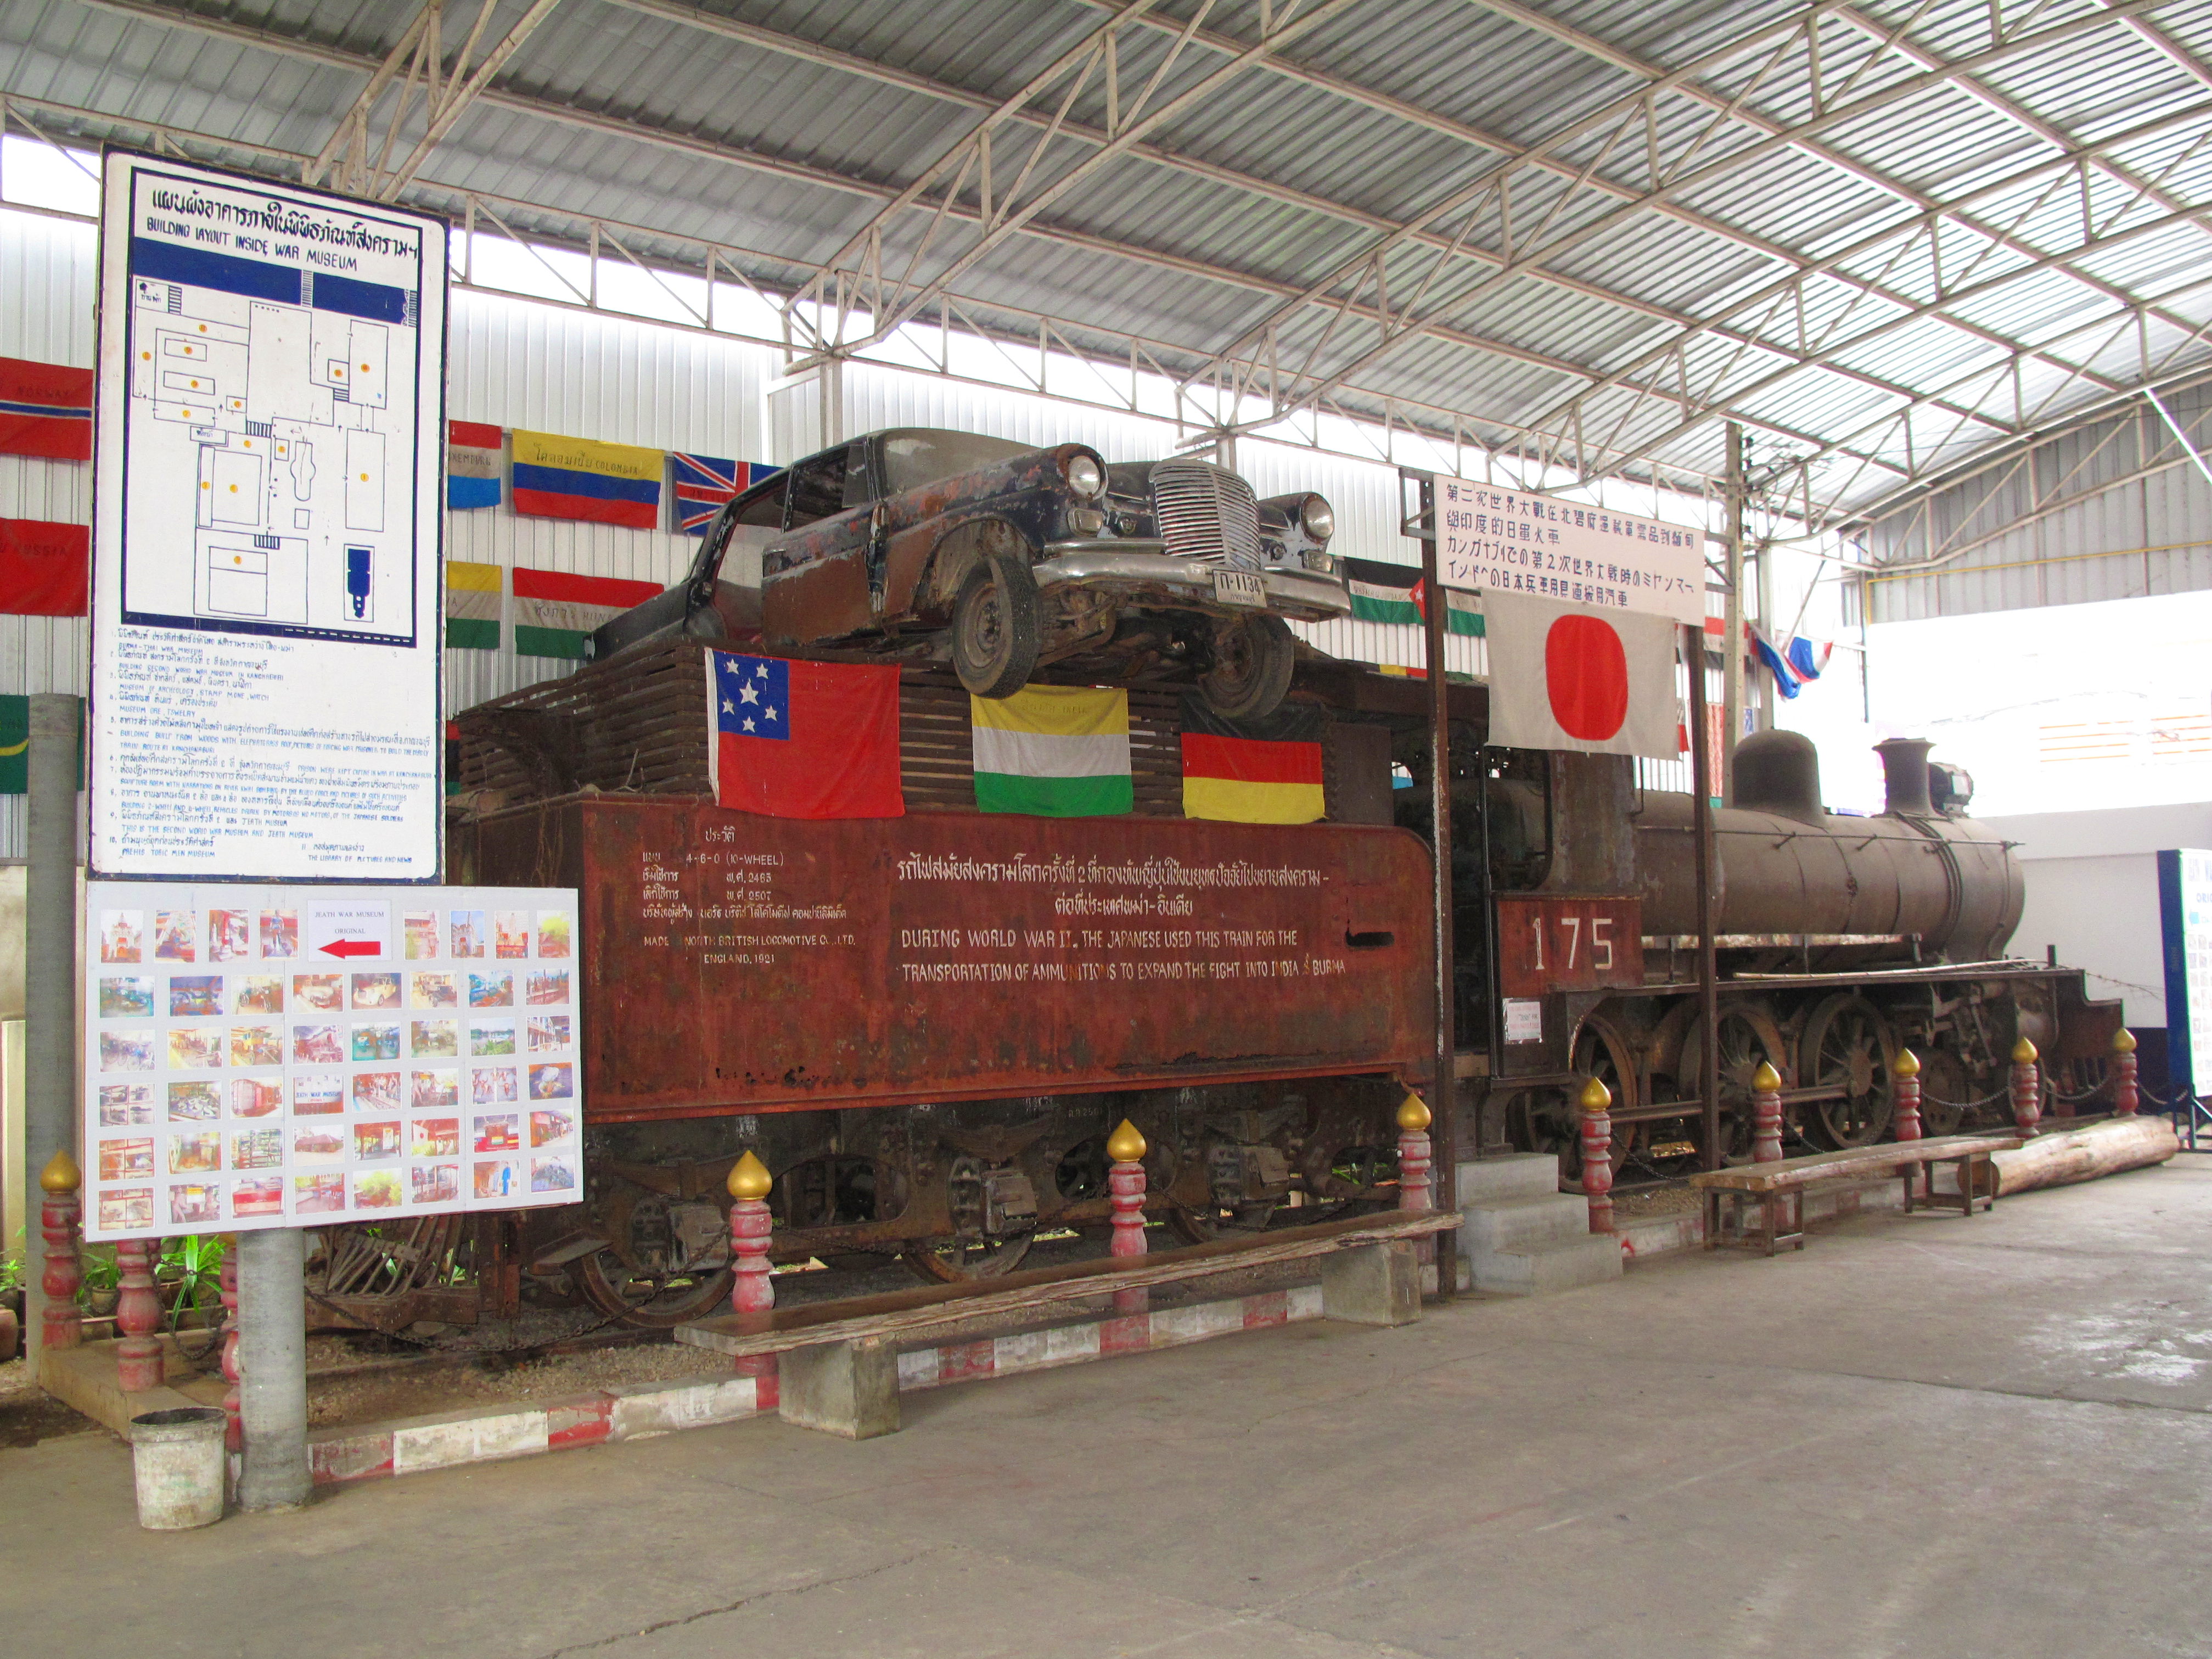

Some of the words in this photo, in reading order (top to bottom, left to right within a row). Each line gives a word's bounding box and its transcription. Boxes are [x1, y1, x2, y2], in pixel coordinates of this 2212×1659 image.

[147, 217, 190, 238] BUILDING
[235, 235, 269, 256] INSIDE
[275, 243, 299, 260] WAR
[306, 251, 358, 272] MUSEUM
[596, 461, 638, 475] COLOMBIA
[211, 669, 232, 677] MUSEUM
[120, 729, 149, 737] BUILDING
[727, 850, 784, 866] (10-WHEEL)
[749, 890, 772, 901] 2507
[644, 936, 669, 946] MADE
[718, 935, 759, 946] BRITISH
[761, 935, 817, 945] LOCOMOTIVE
[902, 929, 960, 948] DURING
[968, 929, 1017, 948] WORLD
[1023, 929, 1056, 948] WAR
[1082, 930, 1103, 948] THE
[1107, 931, 1161, 949] JAPANESE
[1164, 931, 1192, 948] USED
[1195, 931, 1220, 948] THIS
[1223, 930, 1254, 948] TRAIN
[1256, 931, 1276, 947] FOR
[1278, 930, 1298, 946] THE
[1532, 917, 1613, 970] 175
[755, 954, 775, 964] 1921
[902, 963, 1012, 982] TRANSPORTATION
[1014, 963, 1029, 981] OF
[1120, 962, 1134, 979] TO
[1138, 962, 1183, 980] EXPAND
[1184, 962, 1206, 979] THE
[1209, 961, 1240, 979] FIGHT
[1246, 961, 1268, 978] INTO
[1271, 960, 1299, 977] INDIA
[1313, 959, 1346, 977] BURMA
